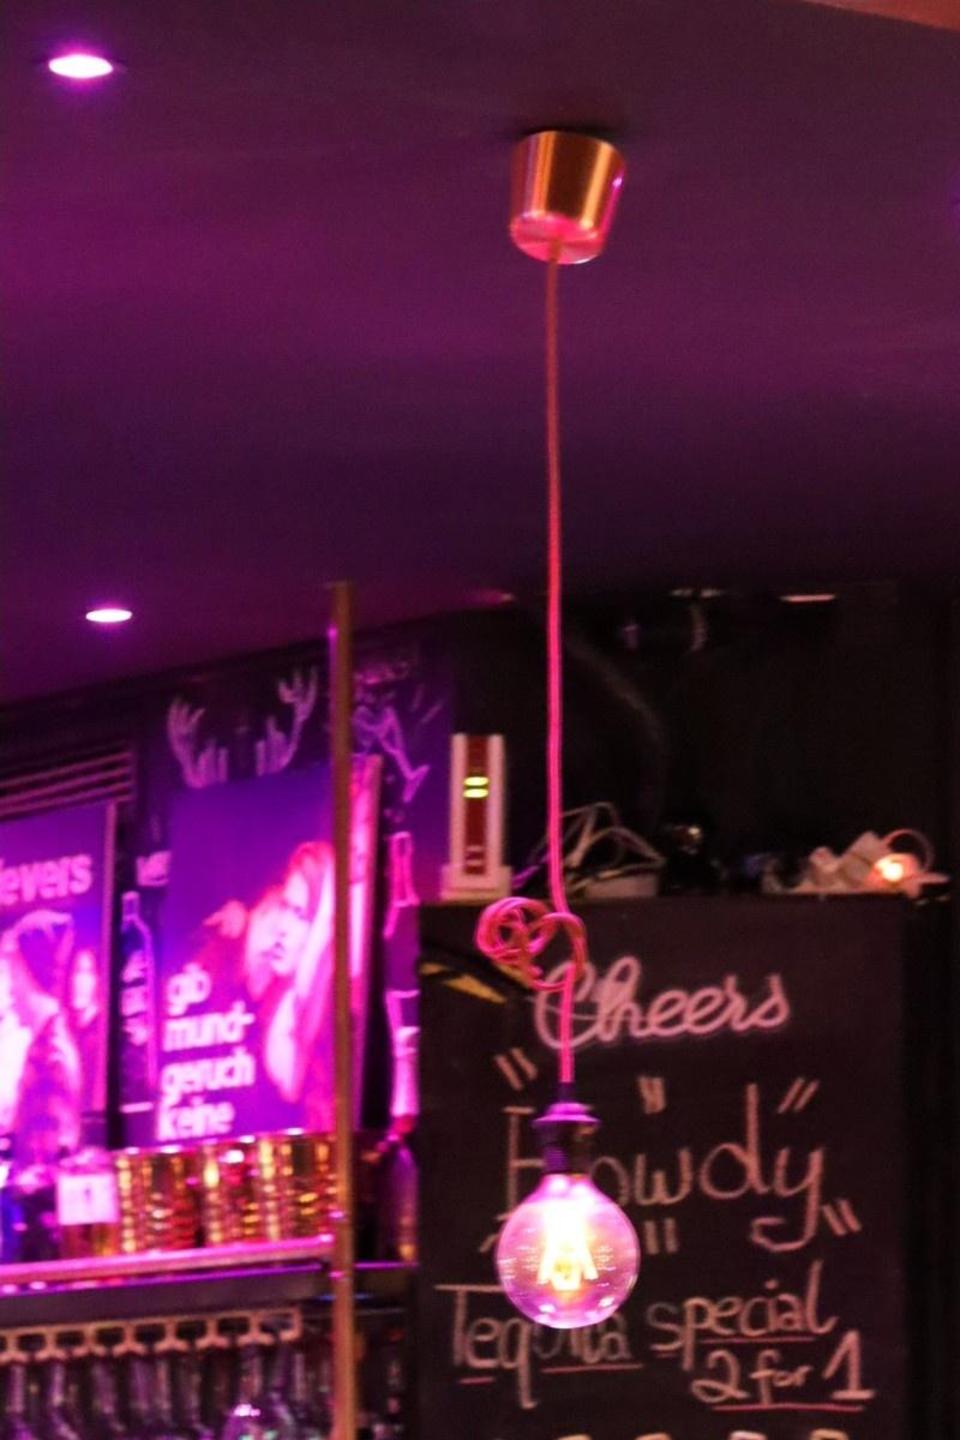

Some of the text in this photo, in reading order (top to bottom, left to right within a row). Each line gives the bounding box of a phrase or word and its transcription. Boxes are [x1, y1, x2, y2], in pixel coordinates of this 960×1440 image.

[162, 1000, 255, 1052] mund-
[536, 957, 790, 1049] Cheers
[160, 1046, 256, 1107] geruch
[155, 1095, 236, 1142] keine
[646, 1260, 841, 1371] special
[691, 1350, 750, 1401] 2
[822, 1330, 876, 1400] 1
